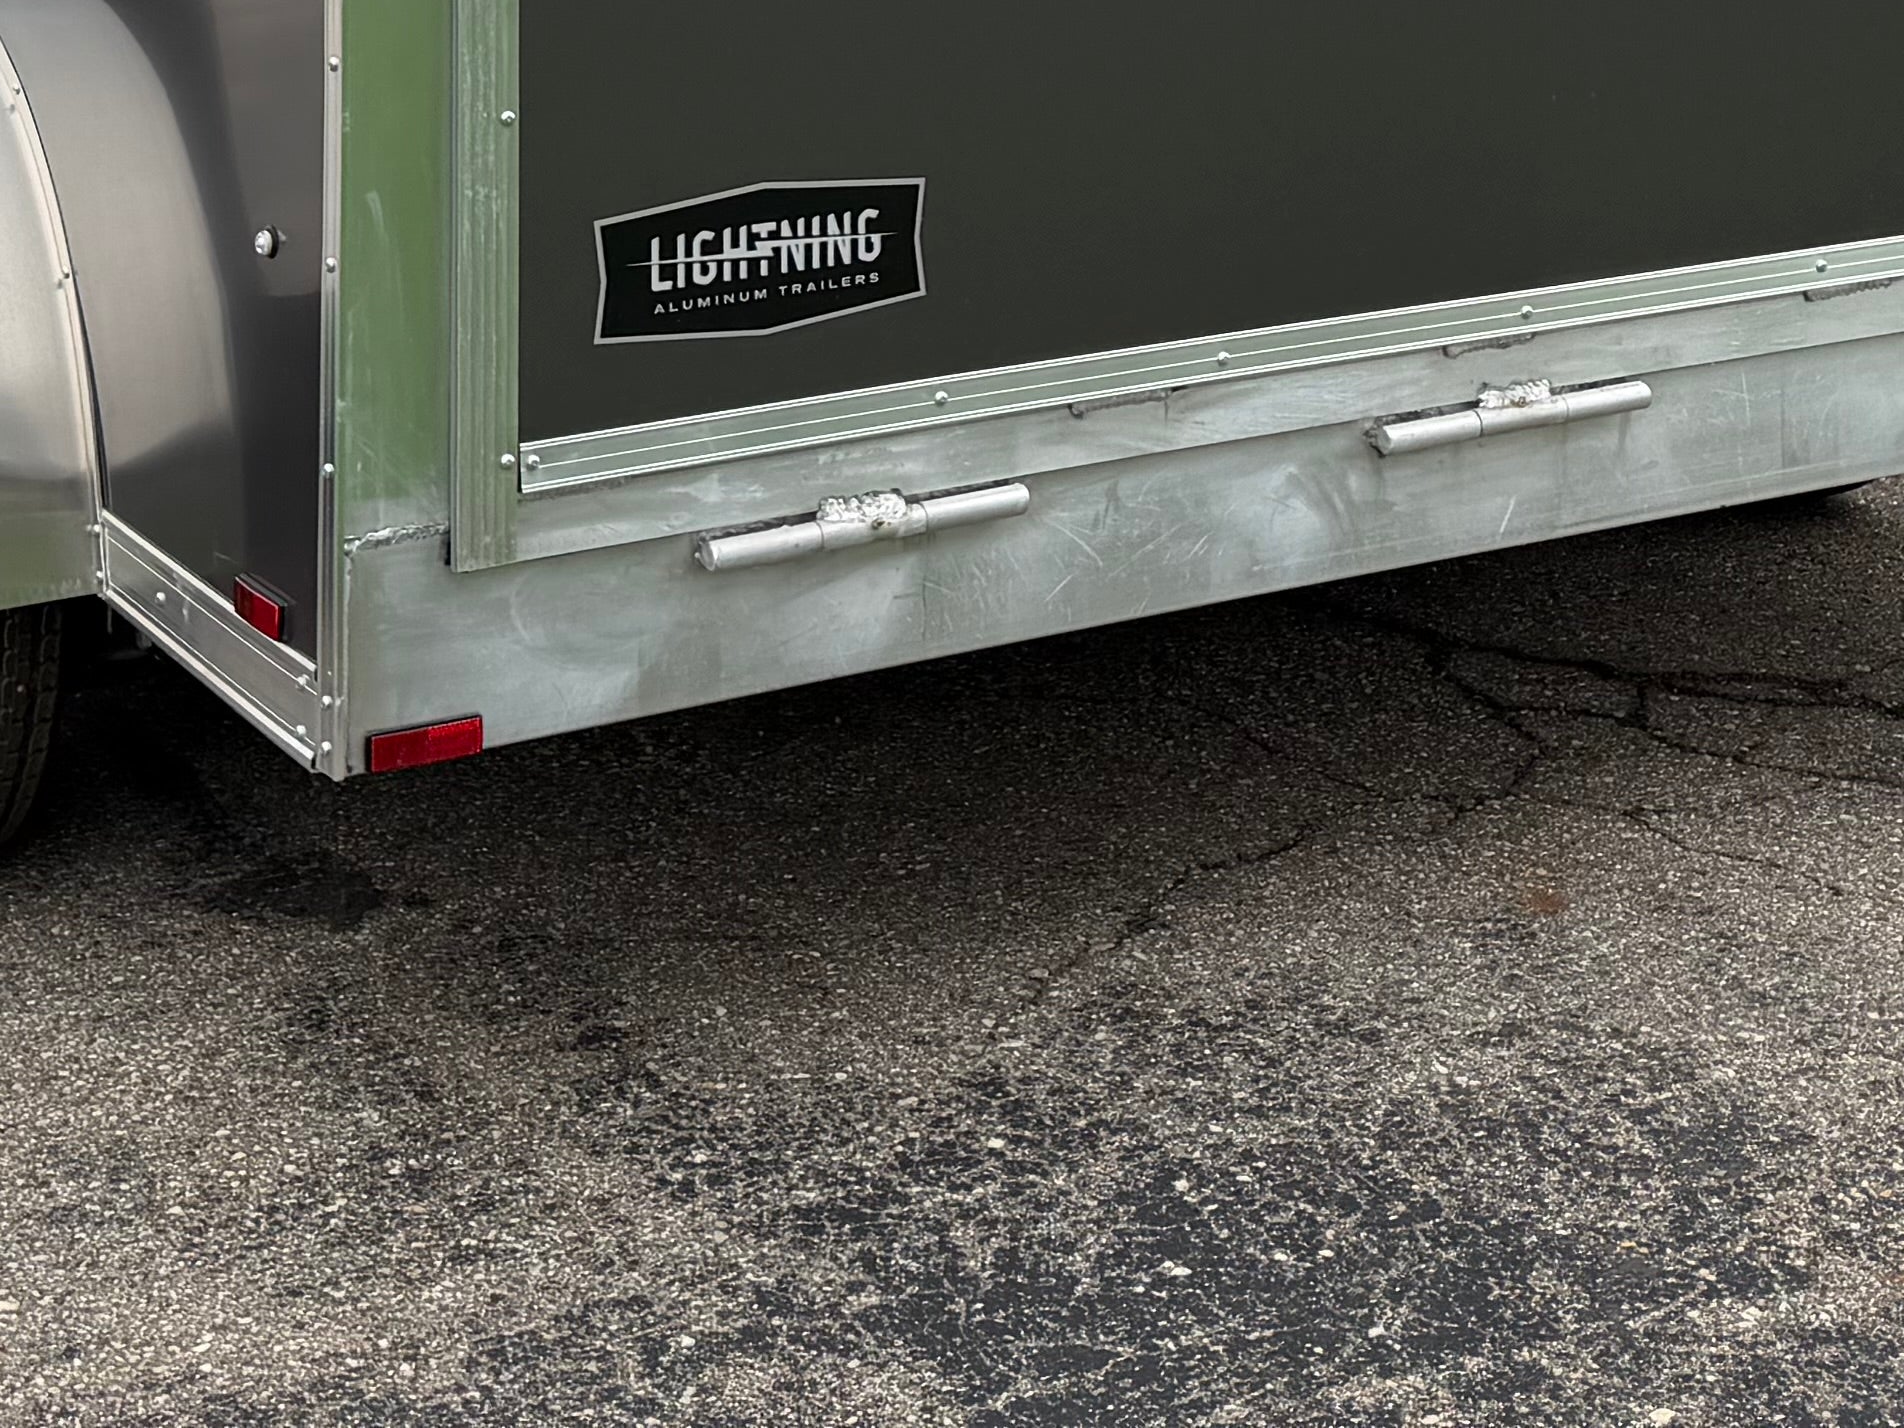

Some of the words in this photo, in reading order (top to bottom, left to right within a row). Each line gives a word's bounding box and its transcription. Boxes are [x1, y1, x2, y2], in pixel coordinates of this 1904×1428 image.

[650, 208, 882, 293] LIGHTNING
[654, 288, 768, 314] ALUMINUM
[779, 272, 880, 297] TRAILERS
